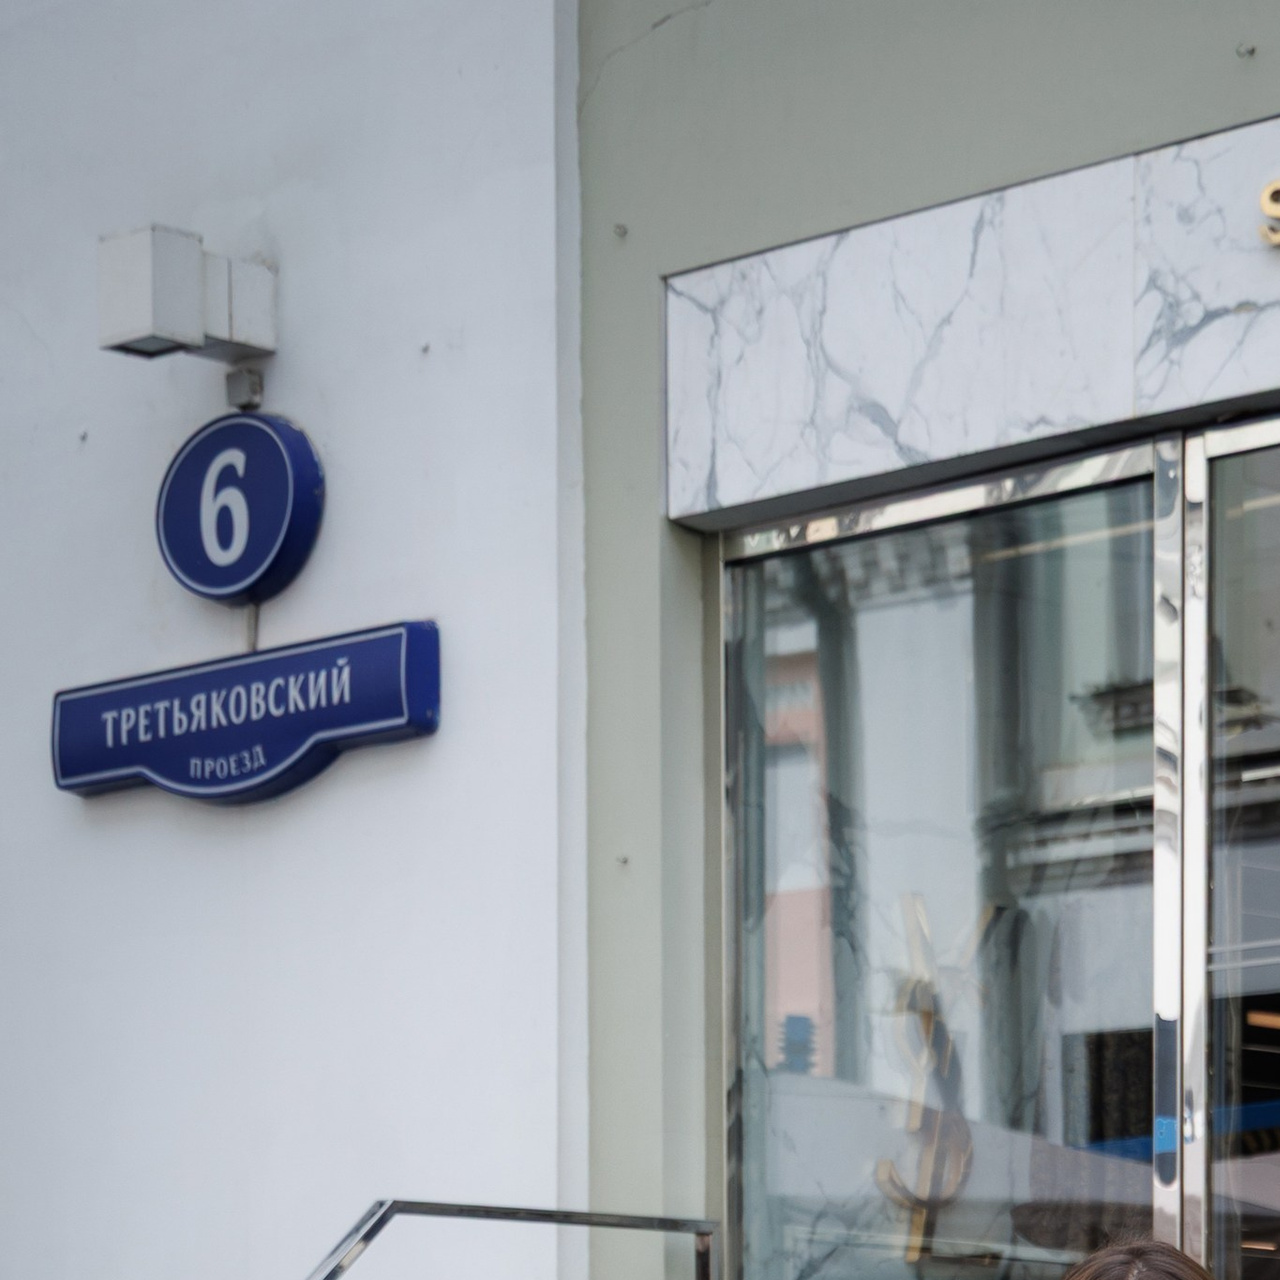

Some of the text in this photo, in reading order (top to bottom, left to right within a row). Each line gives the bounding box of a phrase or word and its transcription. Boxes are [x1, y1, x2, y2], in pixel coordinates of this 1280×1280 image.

[200, 448, 249, 567] 6
[102, 657, 351, 748] ТРЕТЬЯКОВСКИЙ
[190, 744, 267, 780] ПРОЕЗД
